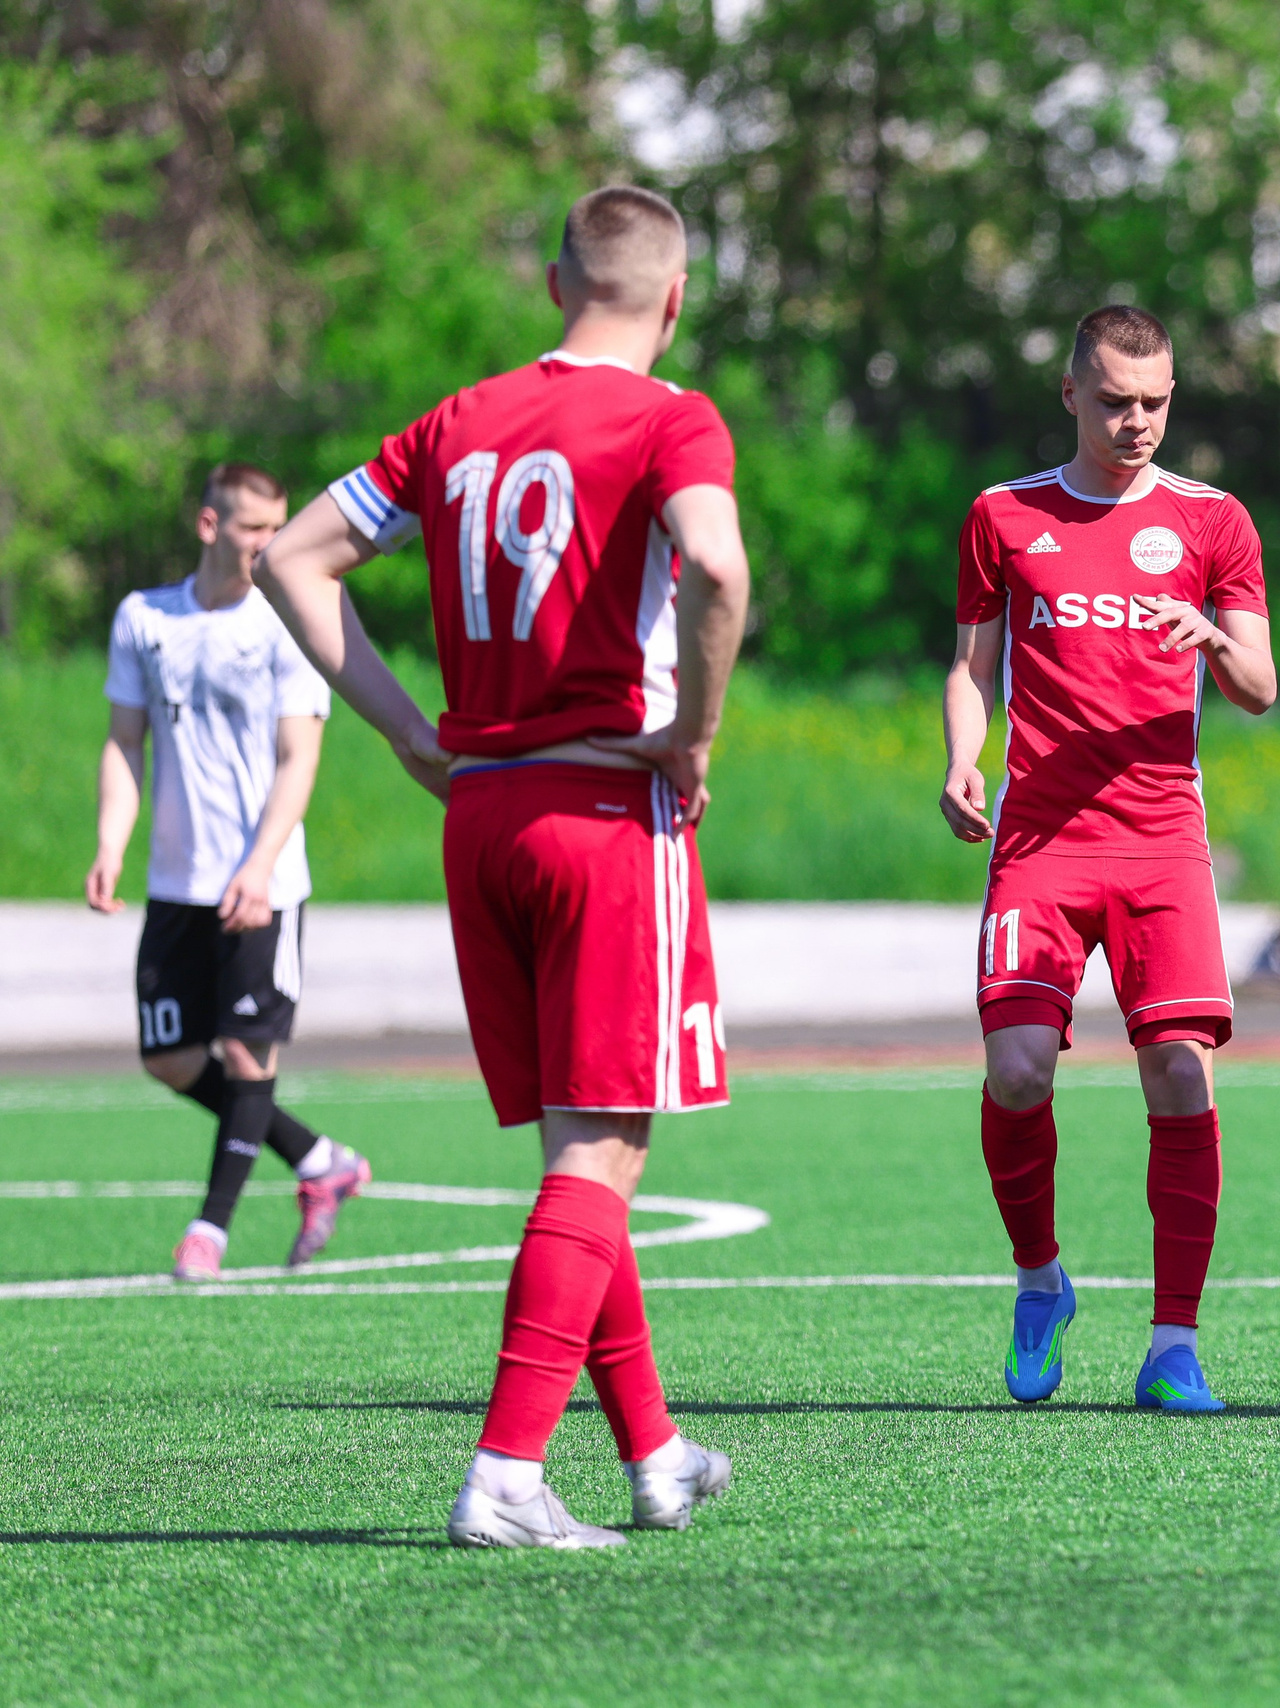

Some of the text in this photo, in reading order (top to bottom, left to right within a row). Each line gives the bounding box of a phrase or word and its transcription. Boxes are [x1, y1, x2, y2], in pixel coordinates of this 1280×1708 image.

[445, 449, 574, 641] 19
[1027, 544, 1062, 554] adidas
[1028, 592, 1191, 631] ASSE
[983, 908, 1021, 977] 11
[140, 997, 183, 1048] 10
